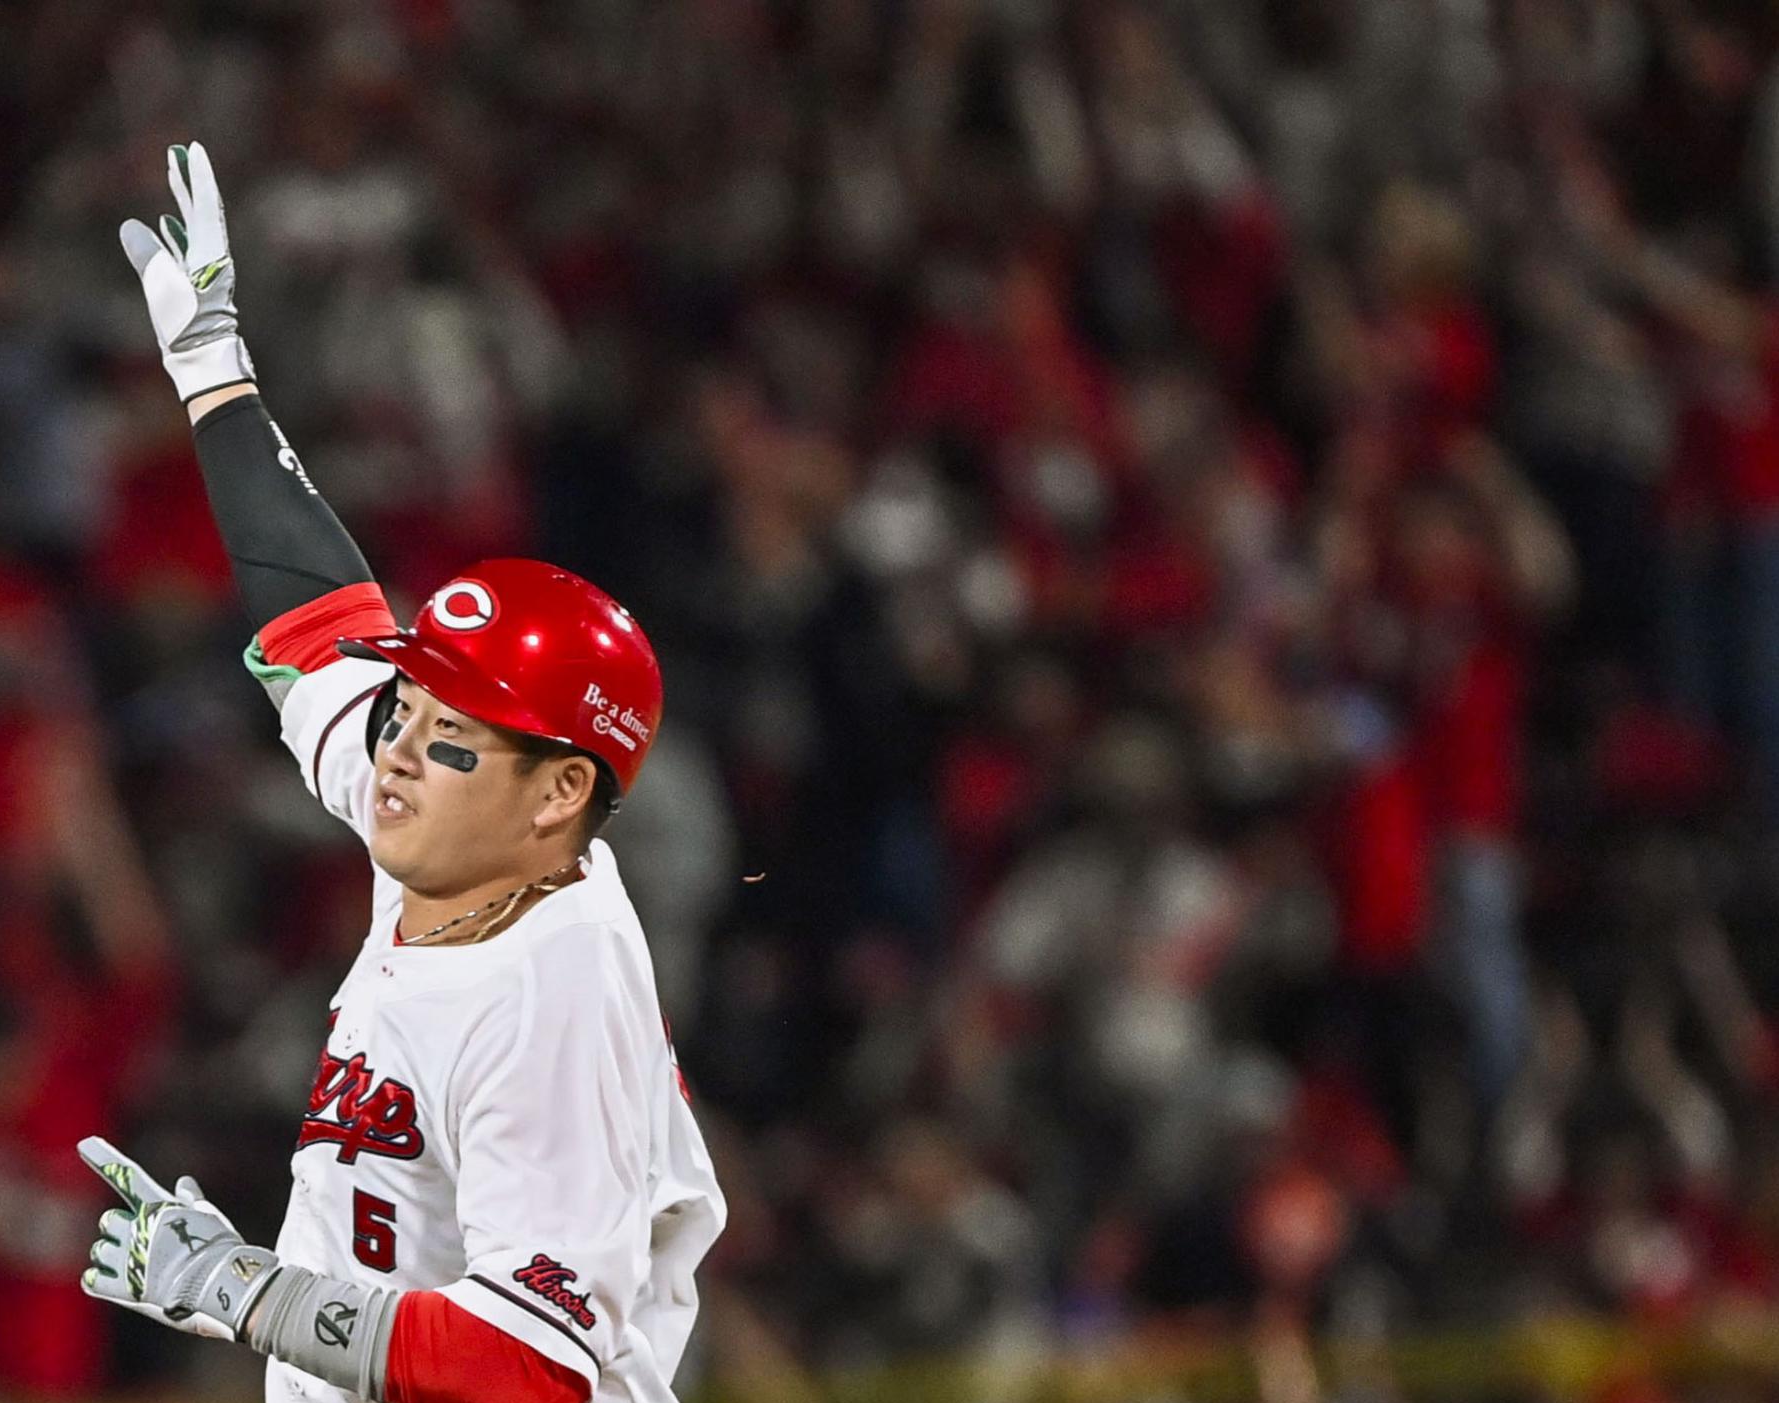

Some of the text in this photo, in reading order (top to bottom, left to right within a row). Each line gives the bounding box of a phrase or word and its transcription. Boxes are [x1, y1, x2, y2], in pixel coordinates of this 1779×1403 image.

[432, 581, 493, 631] C
[583, 682, 609, 711] Be
[607, 703, 620, 719] a
[352, 1186, 397, 1273] 5
